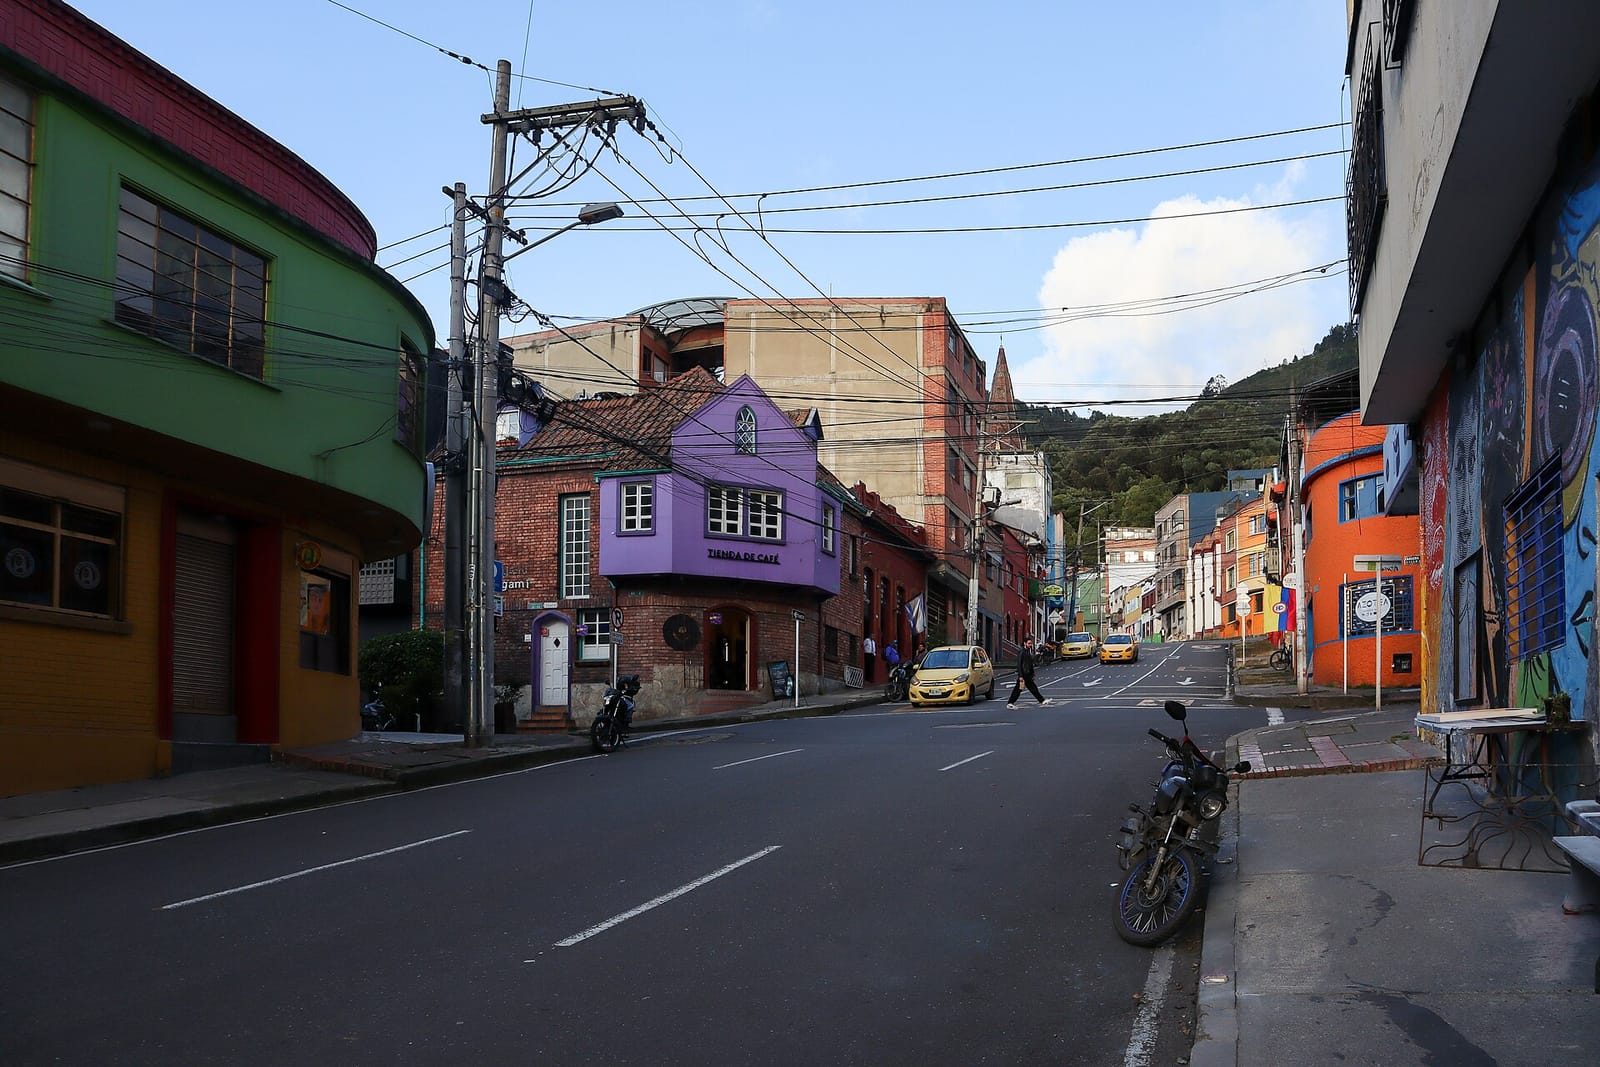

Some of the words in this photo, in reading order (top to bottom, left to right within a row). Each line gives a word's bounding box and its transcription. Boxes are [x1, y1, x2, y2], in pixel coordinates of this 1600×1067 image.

[708, 549, 742, 560] TIENDA
[744, 552, 755, 561] DE
[758, 553, 780, 564] CAFÉ
